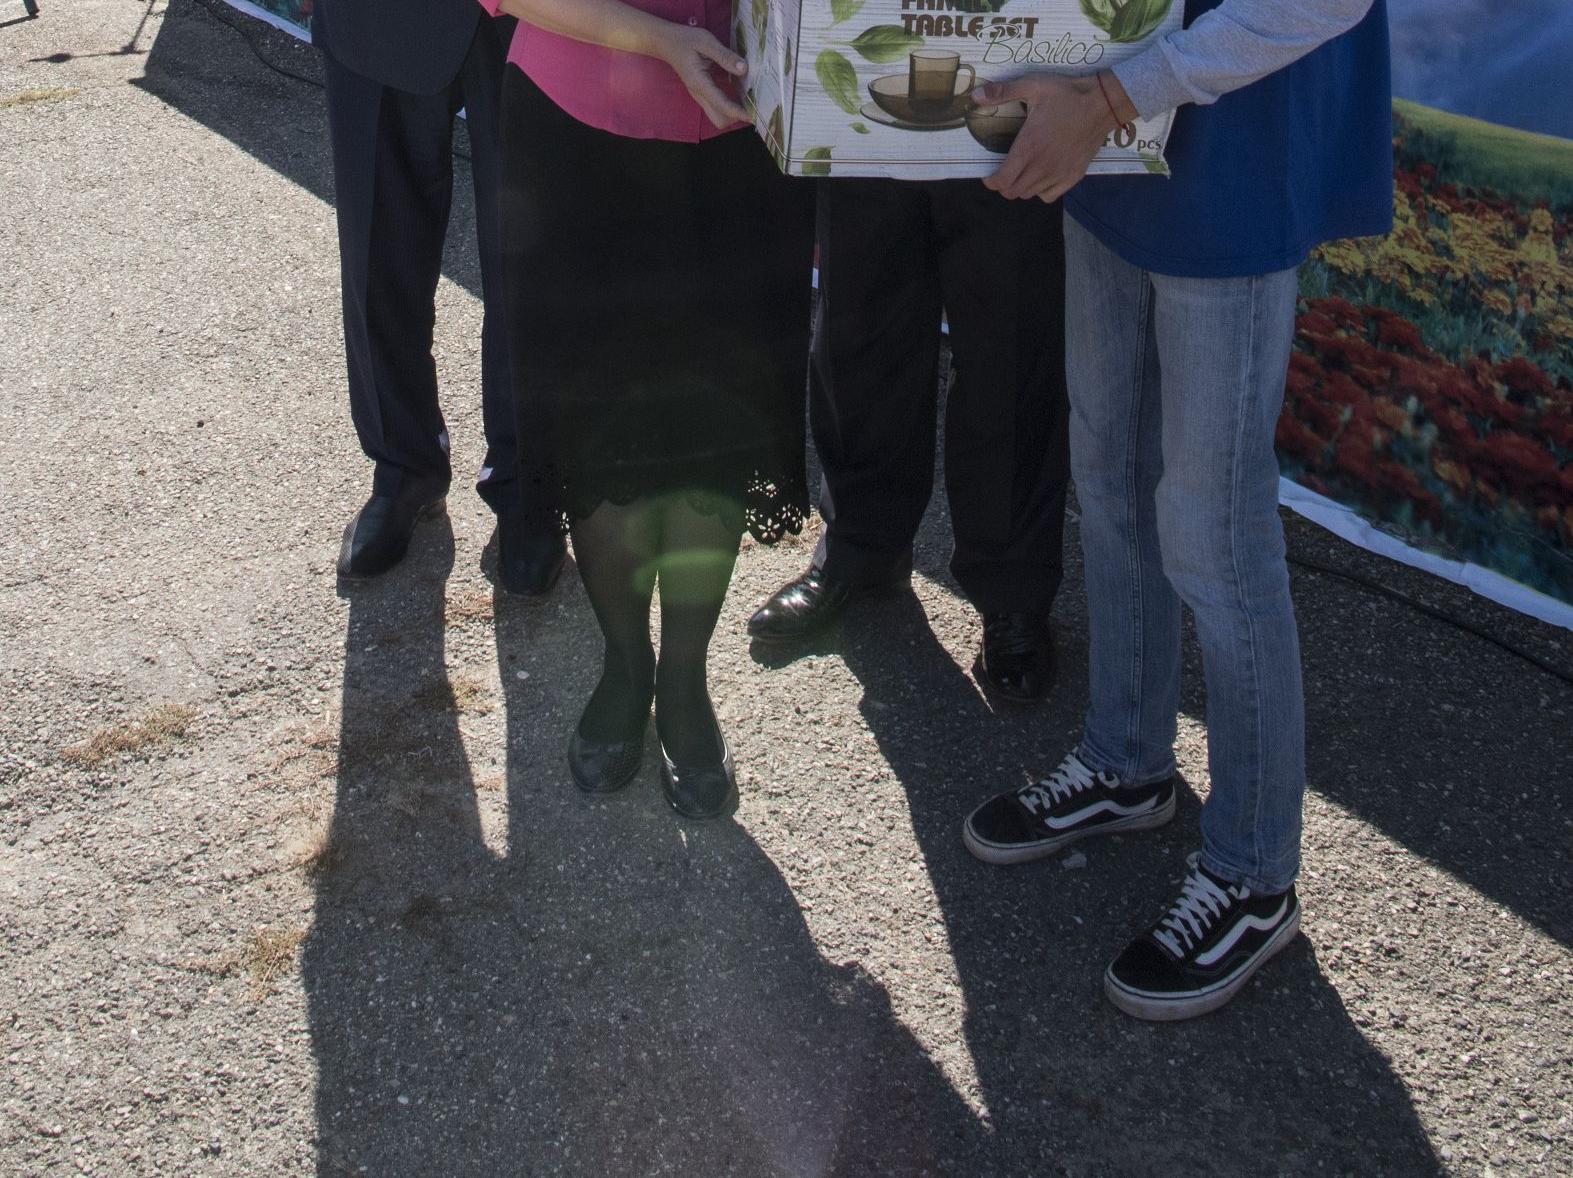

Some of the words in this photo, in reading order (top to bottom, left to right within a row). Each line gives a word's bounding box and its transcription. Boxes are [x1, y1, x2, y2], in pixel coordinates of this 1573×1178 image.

[901, 13, 984, 38] TABLE
[990, 17, 1039, 39] SET
[976, 22, 1104, 65] Basilico
[1103, 121, 1137, 149] 0
[1136, 139, 1162, 152] pcs
